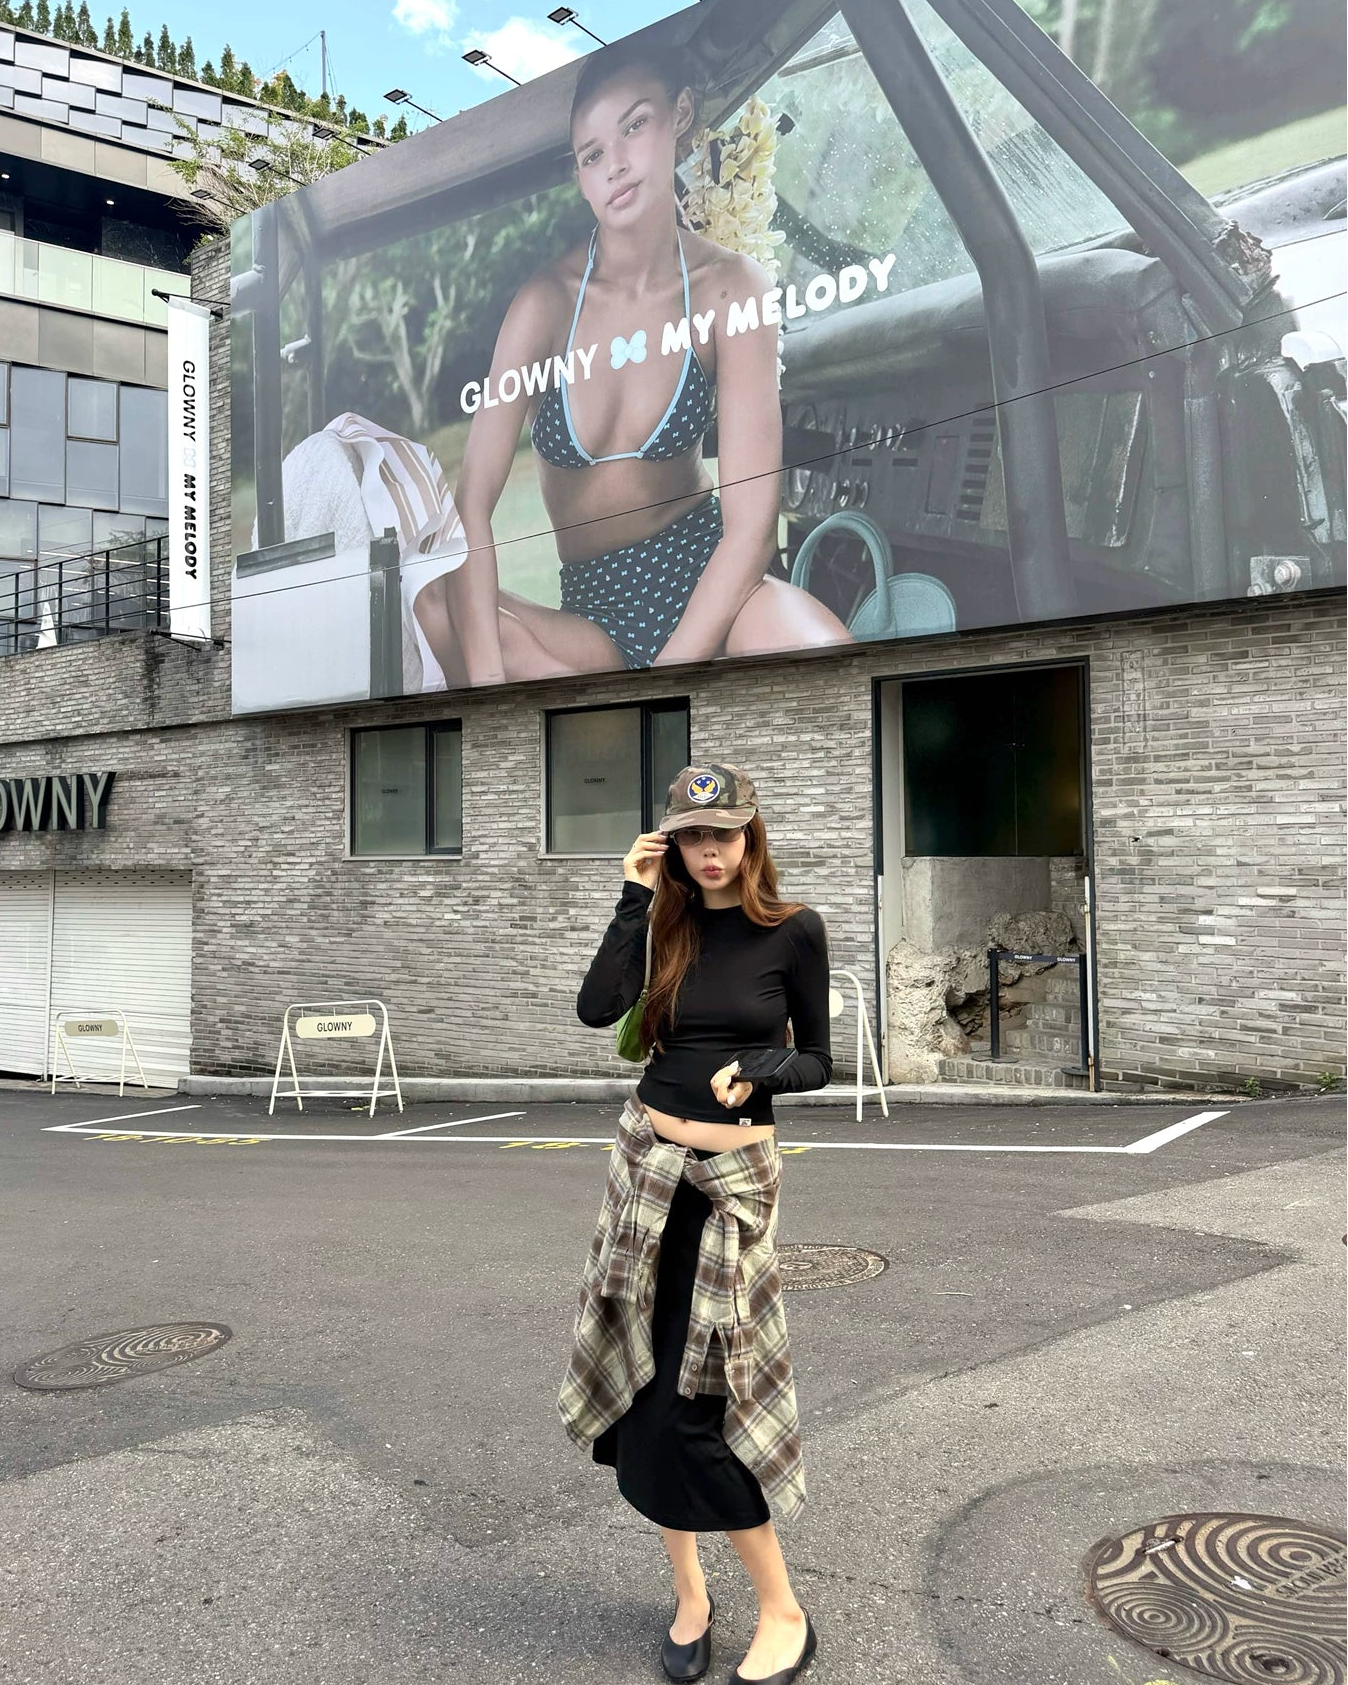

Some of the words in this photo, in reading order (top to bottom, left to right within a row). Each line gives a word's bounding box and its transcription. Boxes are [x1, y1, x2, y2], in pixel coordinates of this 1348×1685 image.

[460, 344, 598, 415] GLOWNY
[660, 310, 716, 356] MY
[726, 254, 897, 337] MELODY
[182, 360, 196, 442] GLOWNY
[184, 473, 196, 502] MY
[184, 505, 197, 580] MELODY
[77, 1024, 103, 1032] GLOWNY
[317, 1021, 353, 1032] GLOWNY
